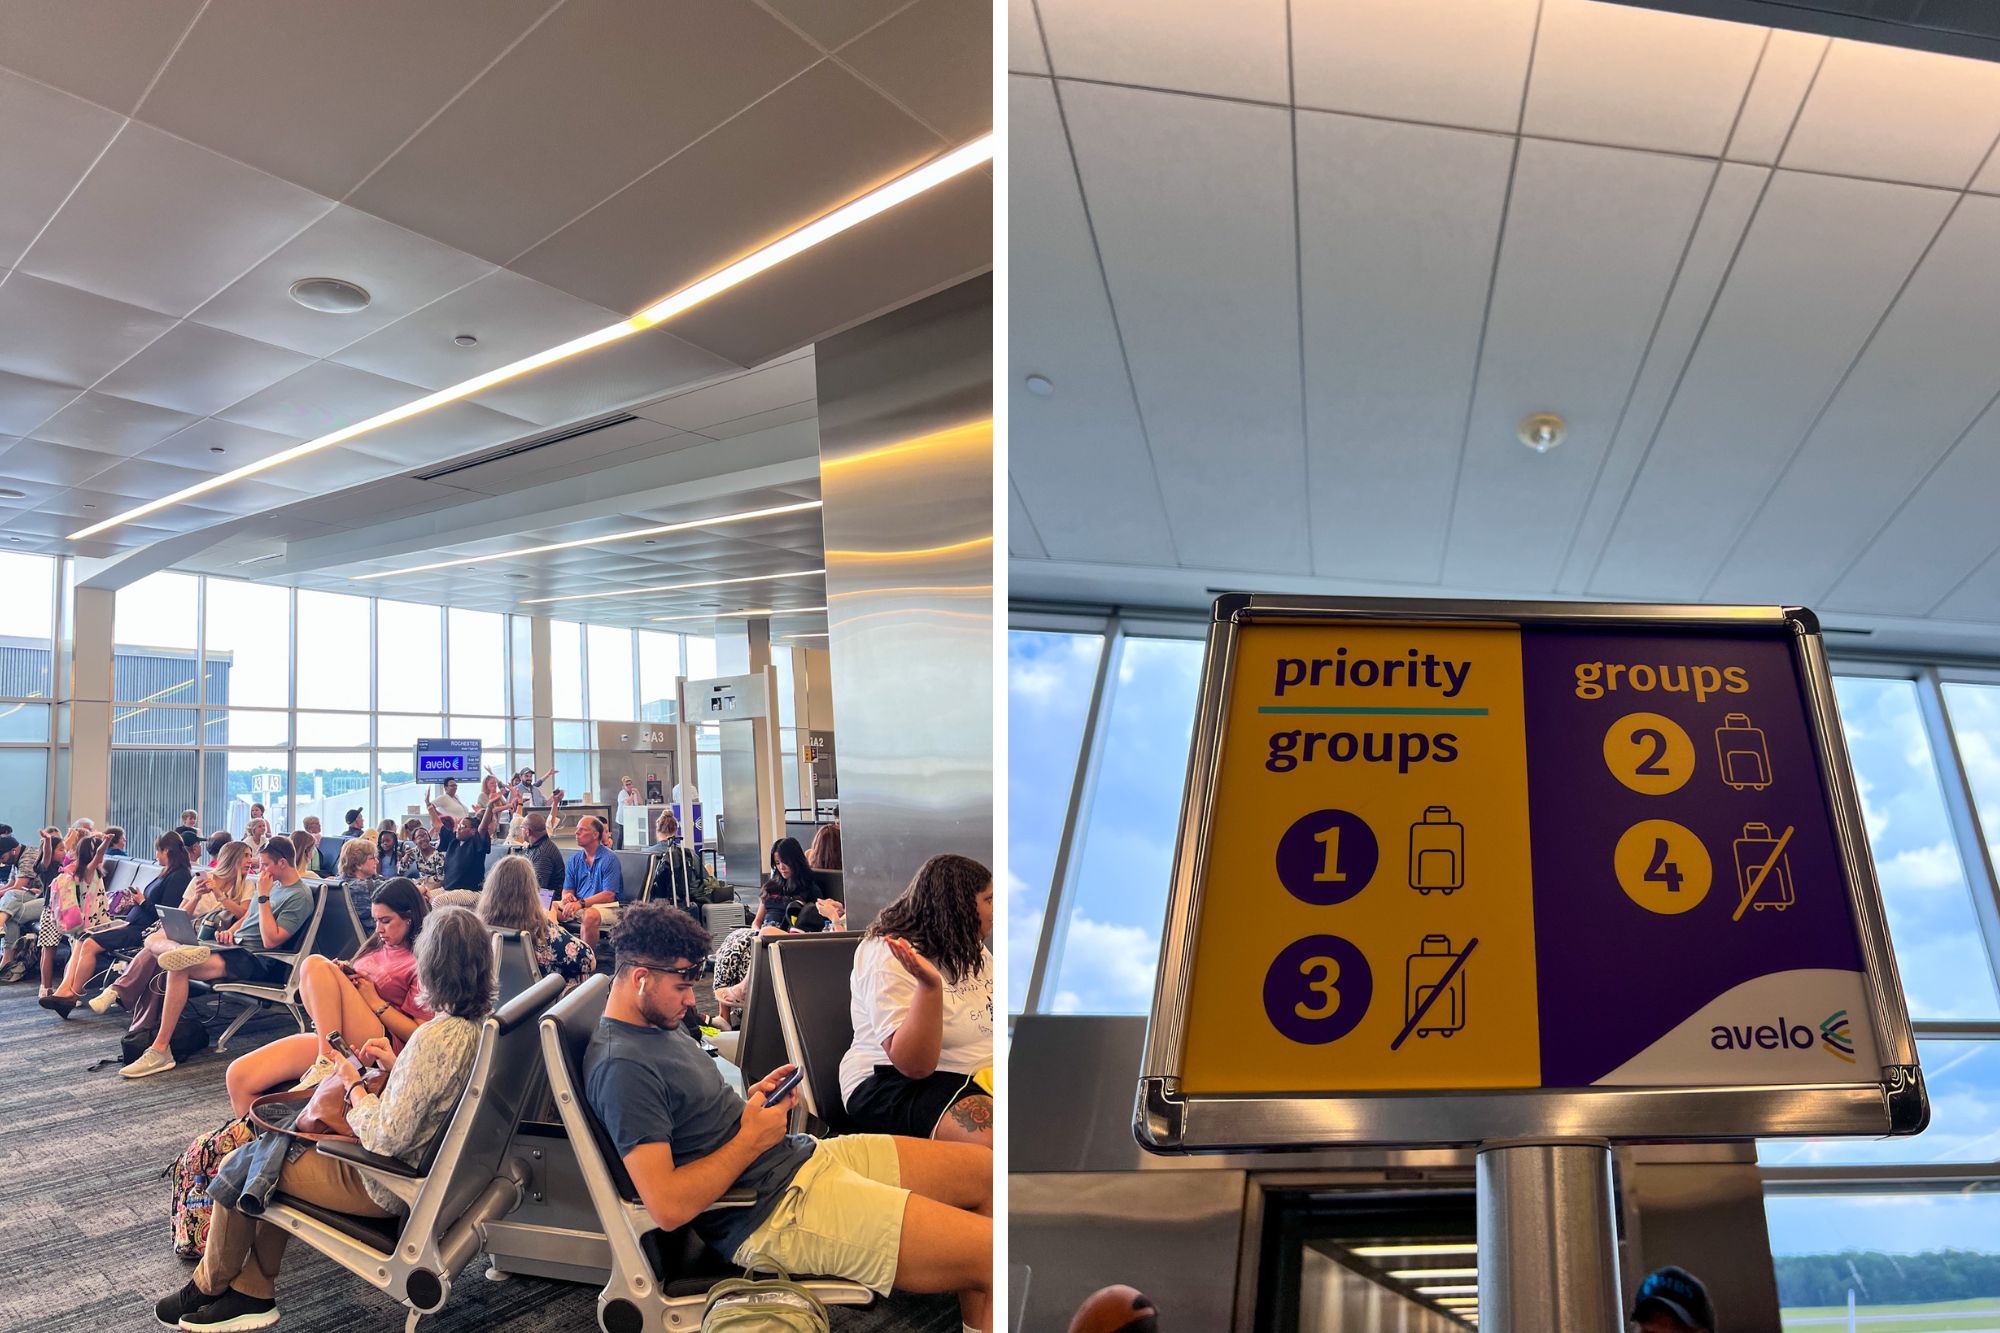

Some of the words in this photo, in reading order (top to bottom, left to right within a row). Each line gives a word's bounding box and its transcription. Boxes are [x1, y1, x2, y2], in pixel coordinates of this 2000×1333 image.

[1273, 646, 1473, 698] priority
[1575, 661, 1749, 703] groups
[425, 757, 451, 769] avelo
[1264, 728, 1459, 775] groups
[1630, 728, 1670, 777] 2
[1313, 827, 1346, 881] 1
[1643, 837, 1685, 893] 4
[1294, 956, 1340, 1020] 3
[1710, 1016, 1815, 1051] avelo
